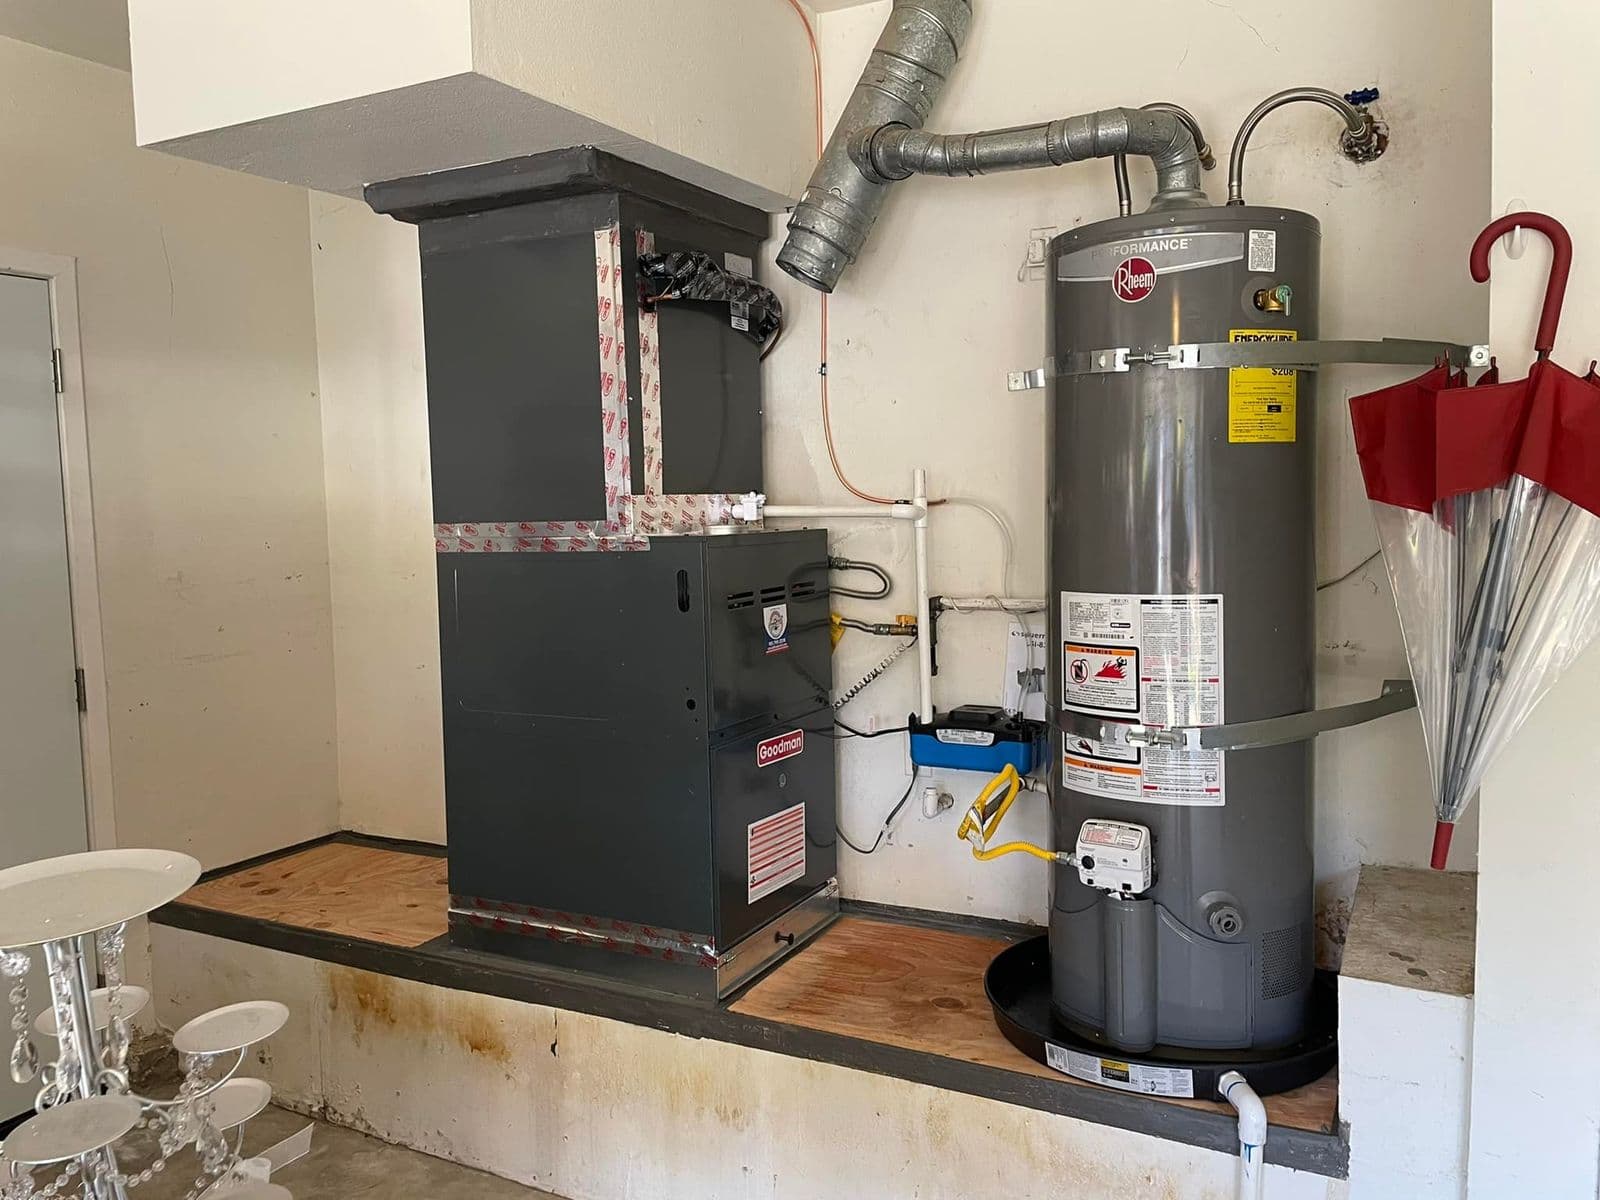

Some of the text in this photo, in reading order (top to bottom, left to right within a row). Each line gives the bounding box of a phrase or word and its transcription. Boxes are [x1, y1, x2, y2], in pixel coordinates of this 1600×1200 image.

[1091, 239, 1189, 259] PRFORMANCE
[1118, 258, 1154, 295] Rheem
[760, 736, 802, 760] Goodman
